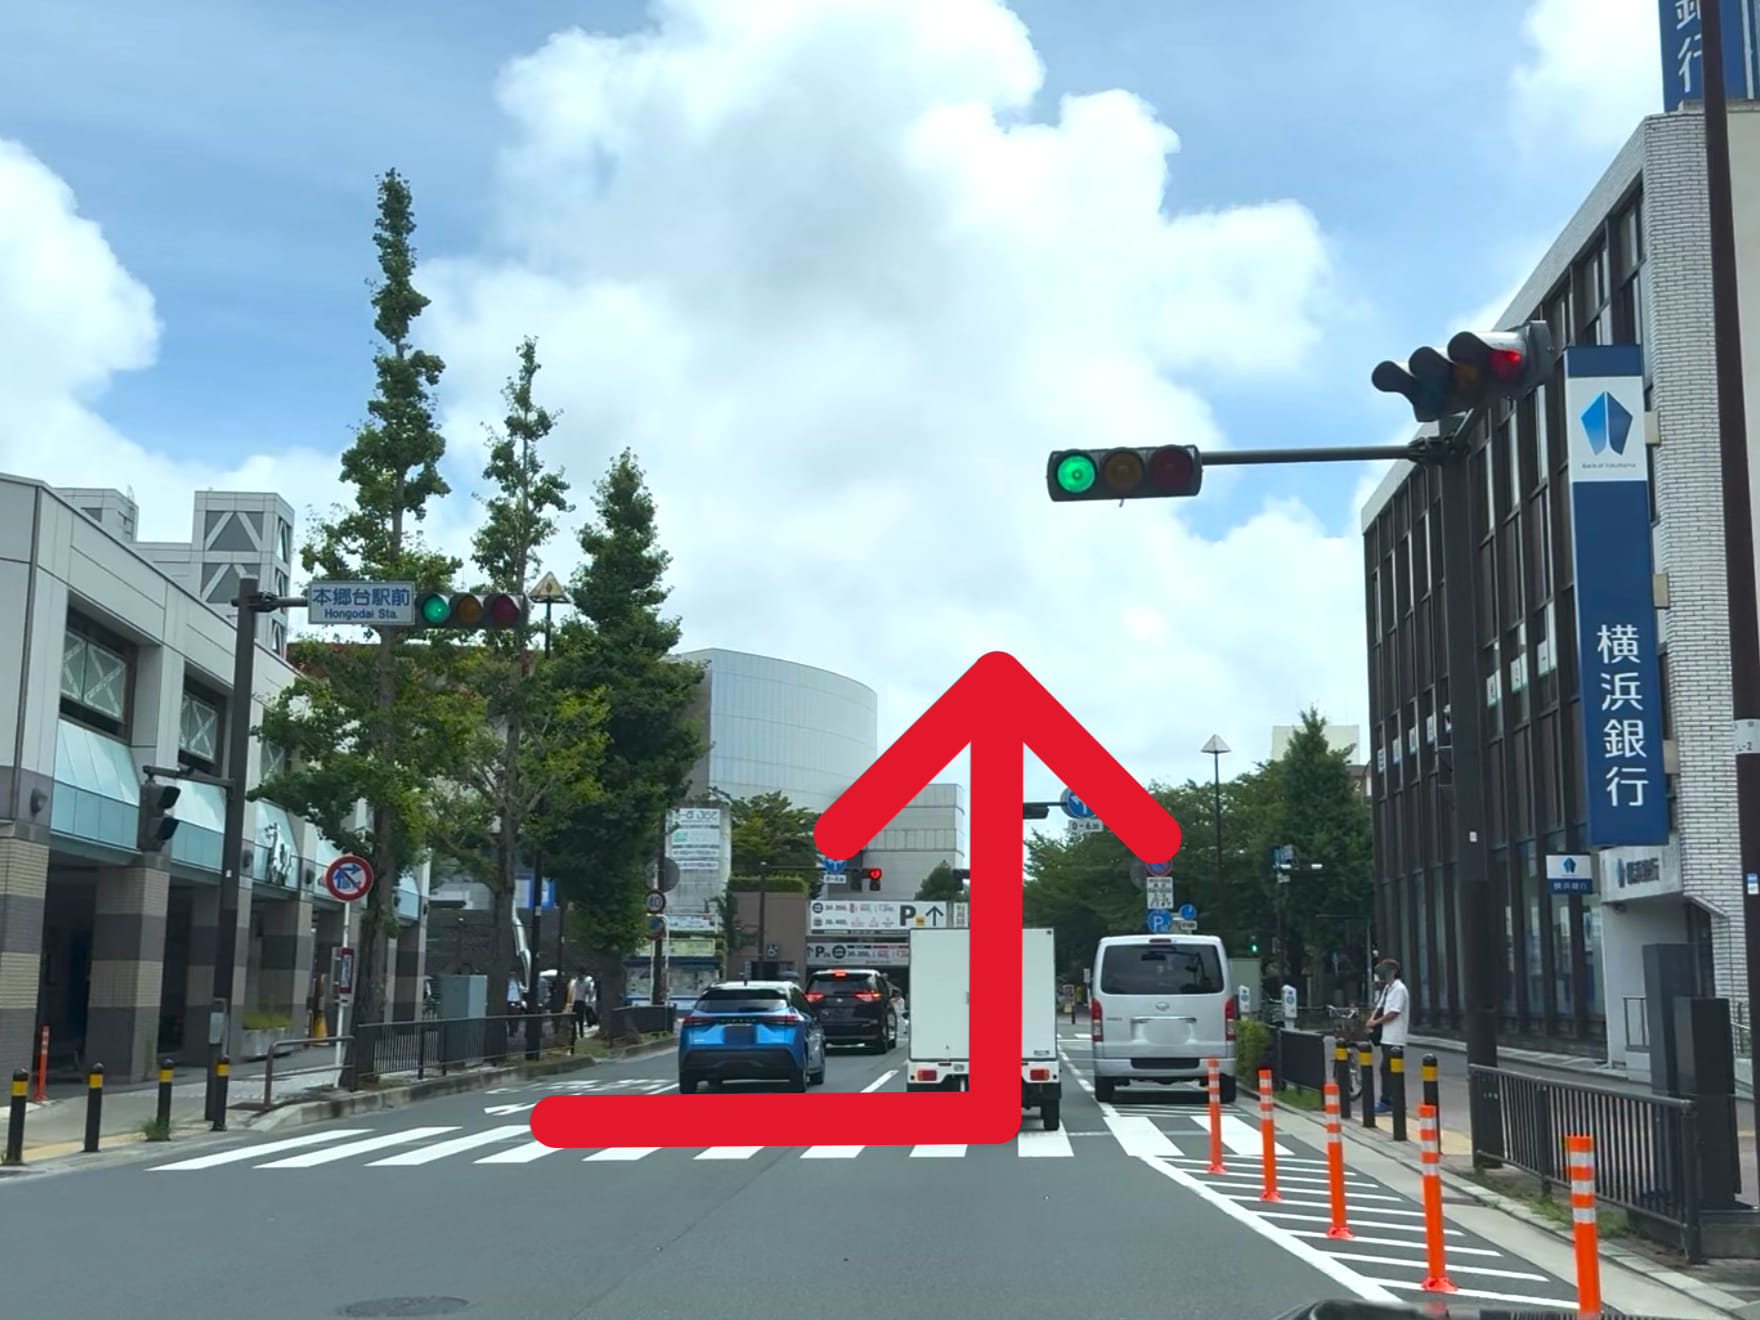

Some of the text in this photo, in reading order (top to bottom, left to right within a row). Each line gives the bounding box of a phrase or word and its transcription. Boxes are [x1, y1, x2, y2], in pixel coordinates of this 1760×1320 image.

[312, 587, 410, 607] 本郷台駅前
[324, 608, 375, 620] Hongodai
[1596, 624, 1649, 807] 横浜銀行
[899, 904, 917, 927] P
[1153, 915, 1164, 932] P
[815, 945, 825, 958] P
